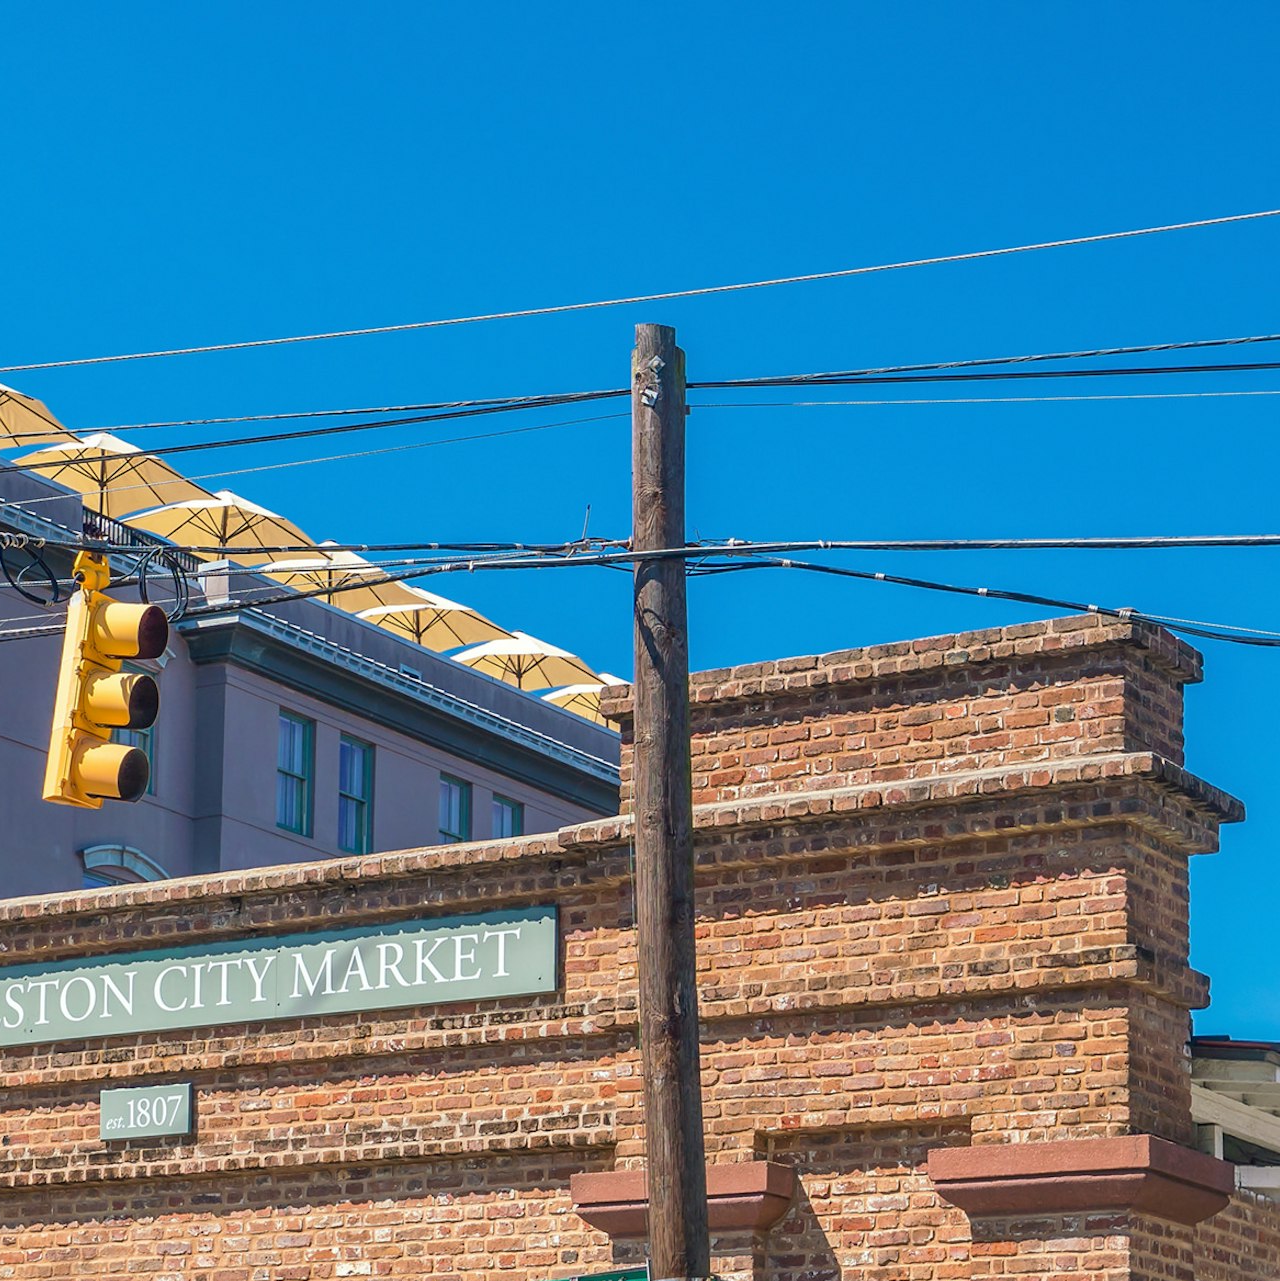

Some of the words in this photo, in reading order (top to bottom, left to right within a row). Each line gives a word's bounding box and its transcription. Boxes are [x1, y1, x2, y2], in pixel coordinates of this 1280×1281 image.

[153, 955, 278, 1012] CITY
[289, 927, 522, 999] MARKET
[127, 1095, 183, 1129] 1807
